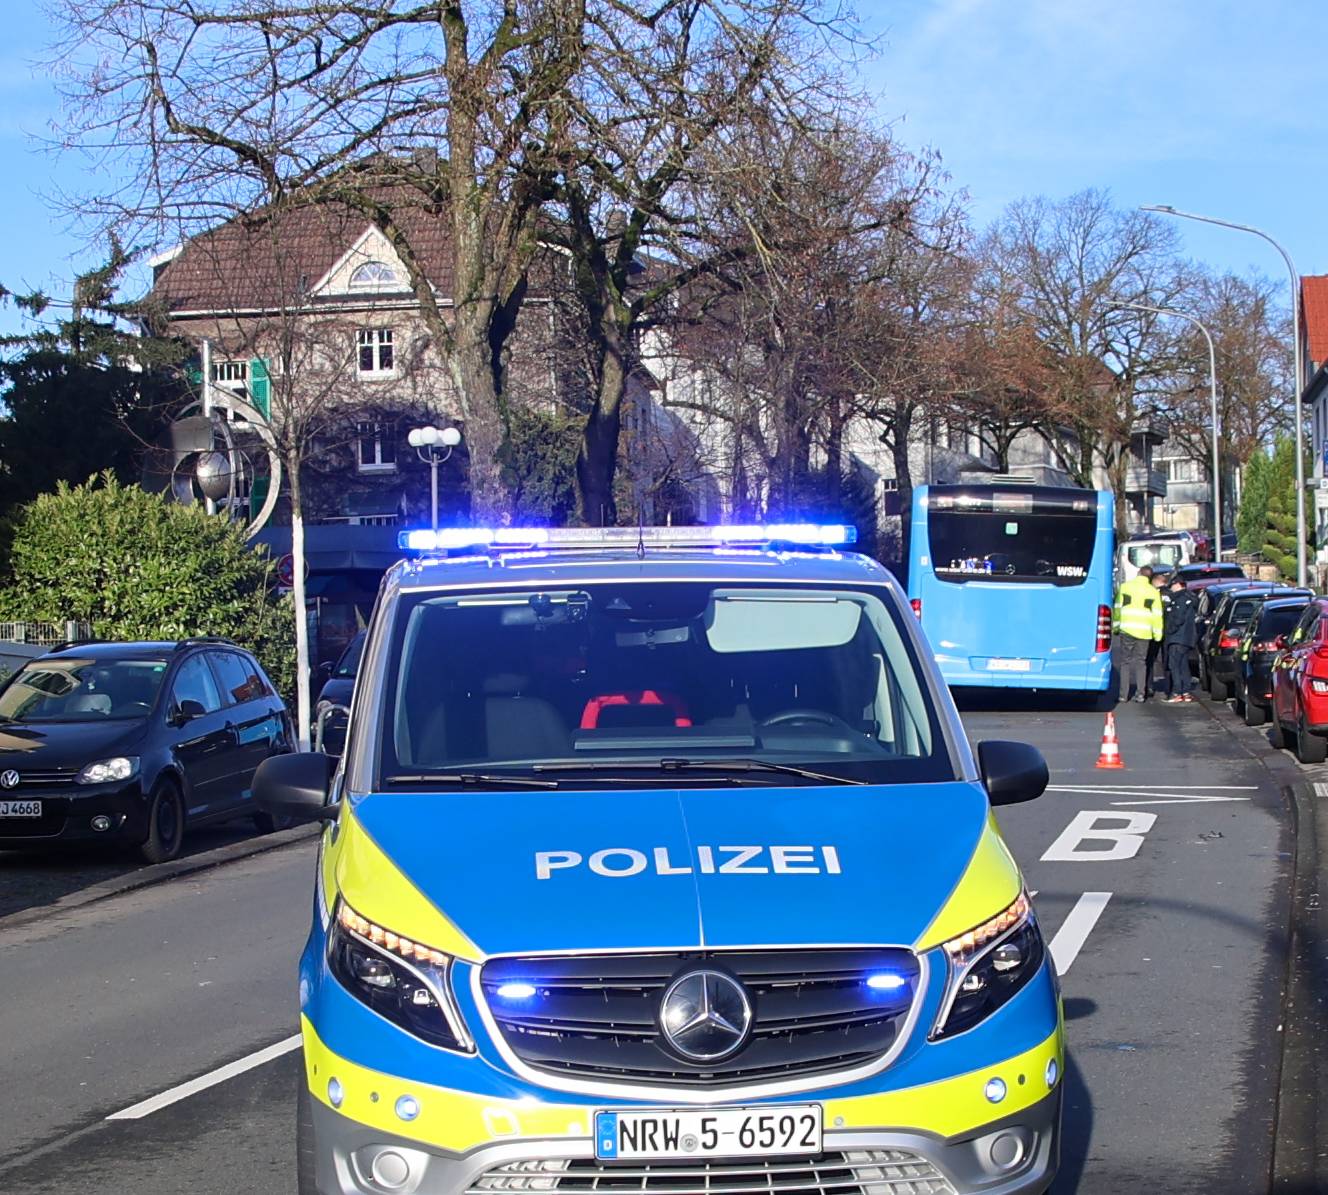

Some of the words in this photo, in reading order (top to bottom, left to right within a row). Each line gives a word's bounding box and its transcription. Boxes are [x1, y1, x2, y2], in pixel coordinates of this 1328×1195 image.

[11, 802, 40, 815] 4668
[1040, 810, 1158, 861] B
[535, 846, 841, 879] POLIZEI
[619, 1118, 680, 1152] NRW
[701, 1114, 816, 1150] 5-6592
